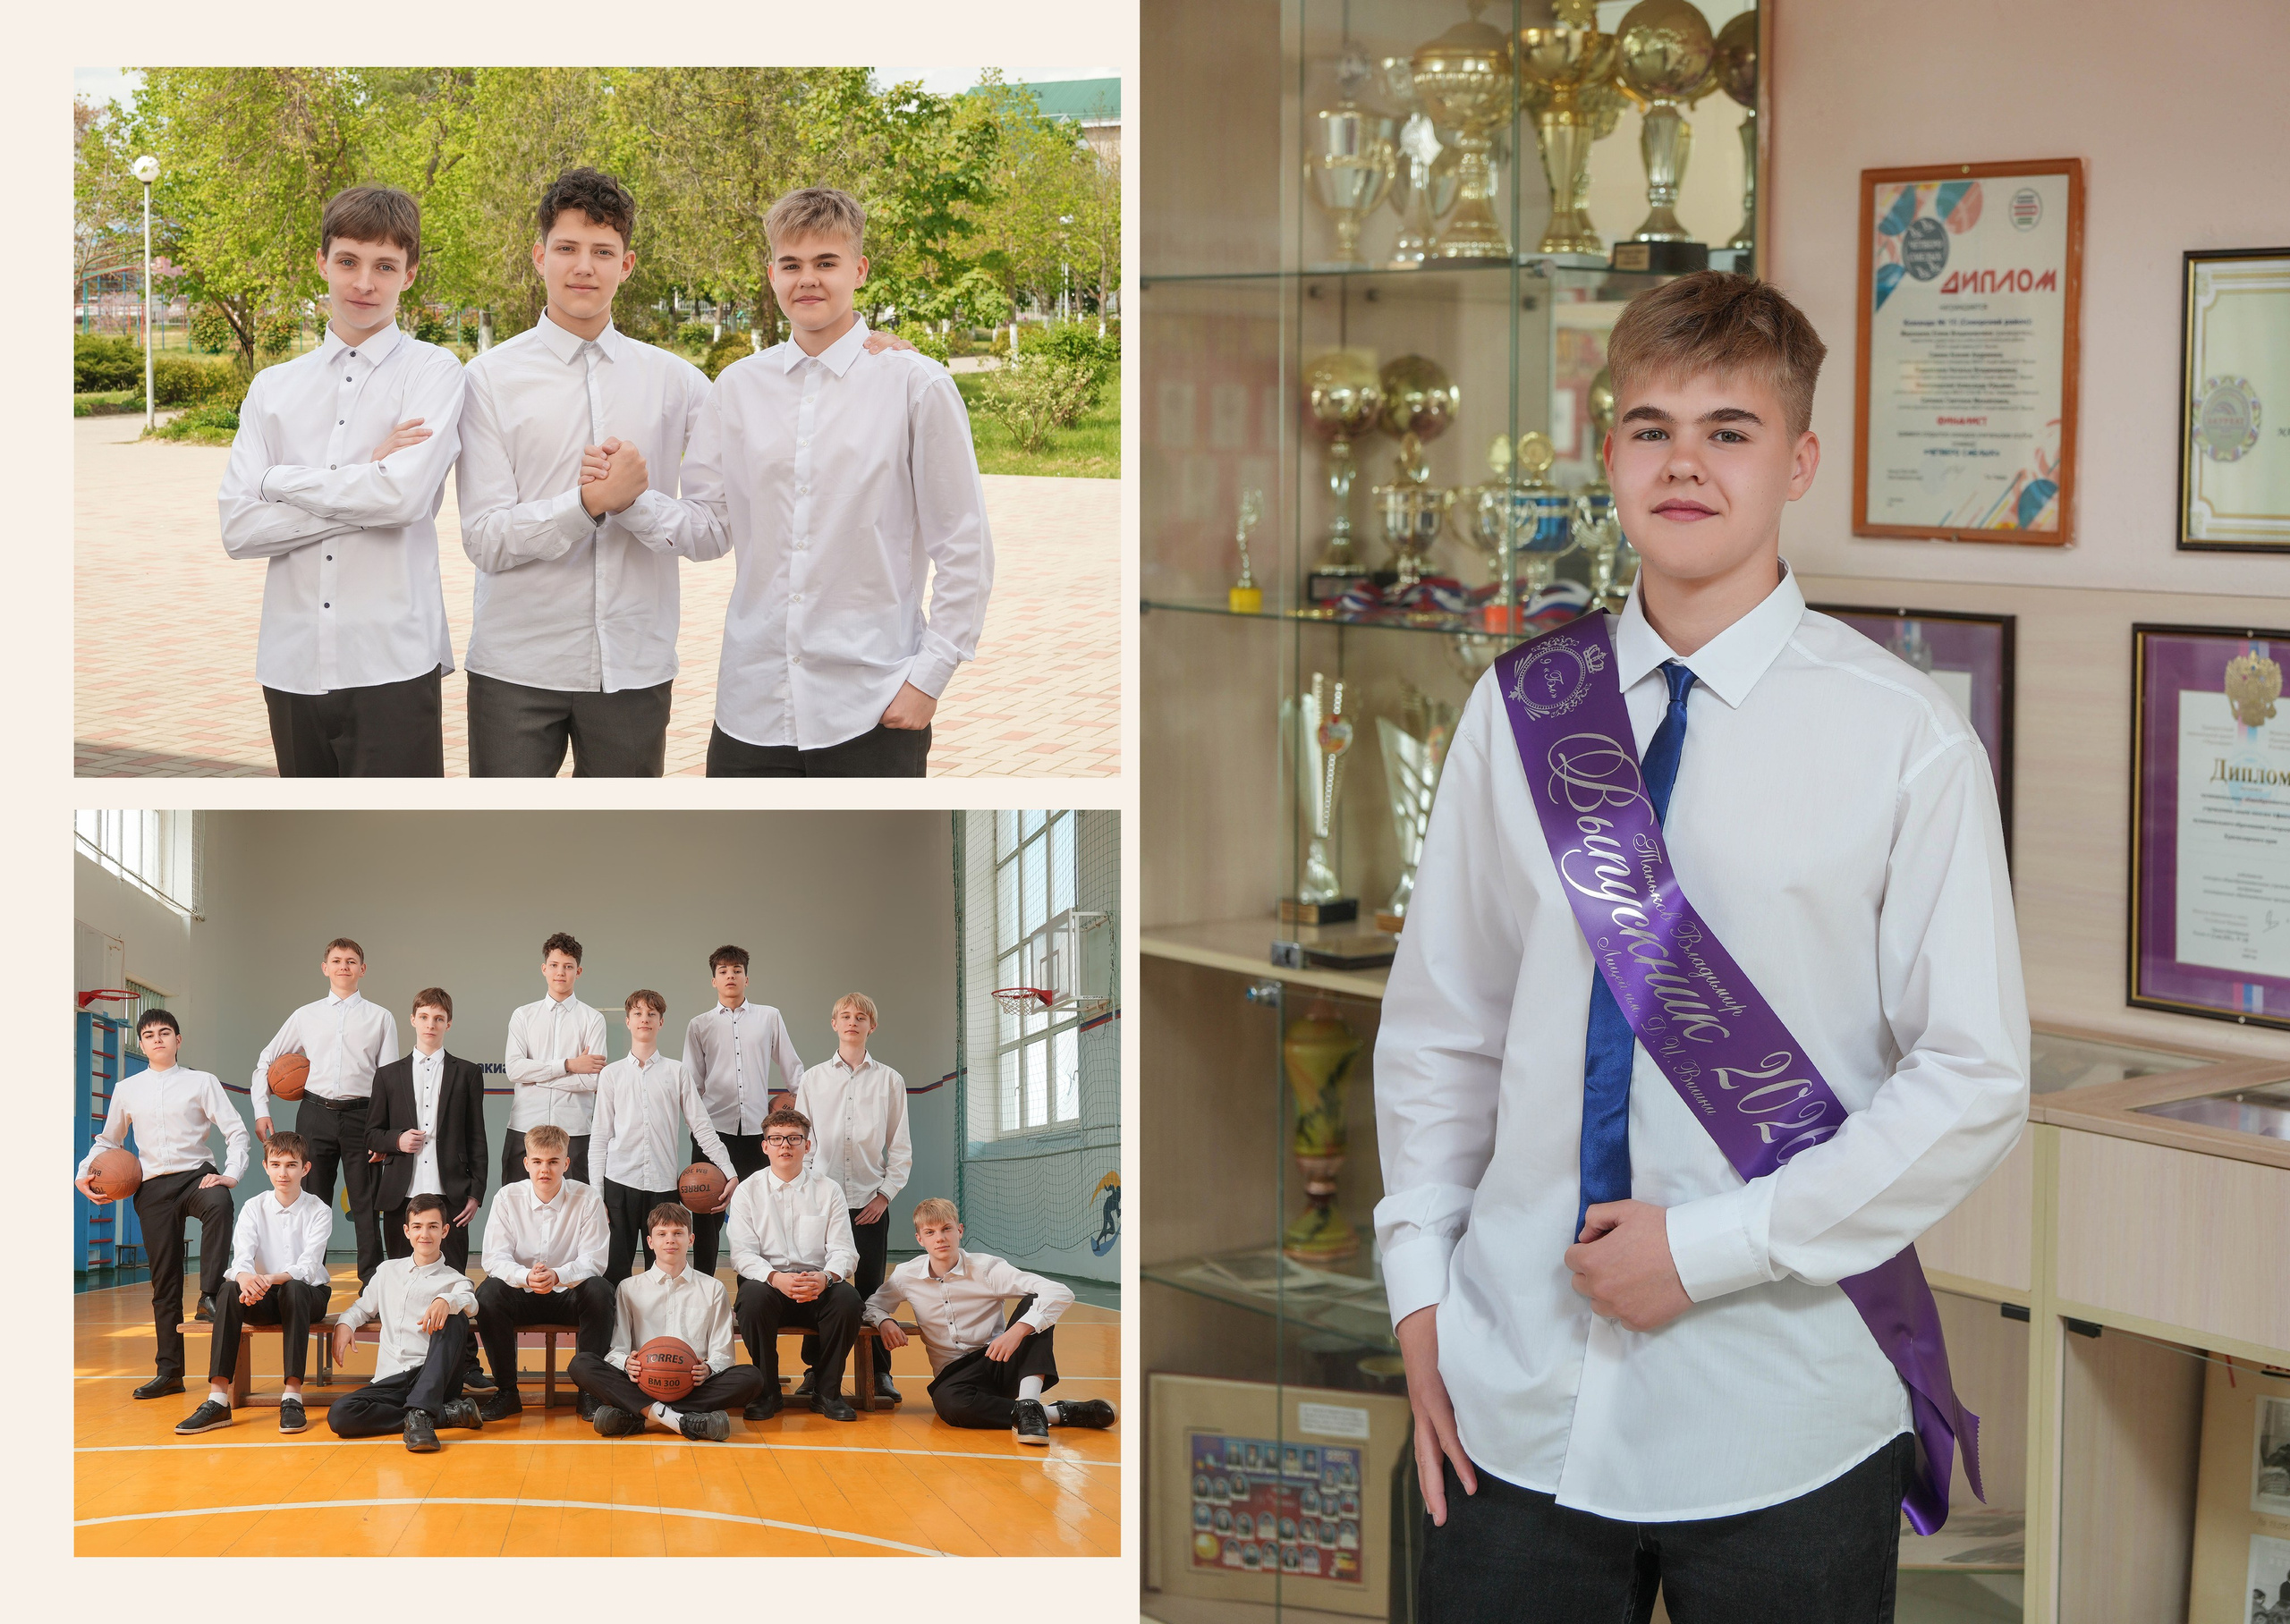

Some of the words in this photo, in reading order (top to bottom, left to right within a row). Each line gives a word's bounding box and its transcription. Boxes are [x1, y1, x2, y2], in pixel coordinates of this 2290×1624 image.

[1940, 268, 2057, 294] ДИПЛОМ
[2209, 757, 2290, 787] Диплом
[1548, 732, 1731, 1044] Выпускник
[1633, 833, 1684, 922] Таньков
[1669, 919, 1748, 1017] Владимир
[1597, 936, 1632, 992] Лицей
[1624, 993, 1641, 1018] им.
[1673, 1058, 1717, 1117] Вишни
[680, 1183, 711, 1194] TORRES
[646, 1353, 683, 1364] TORRES
[649, 1378, 661, 1386] BM
